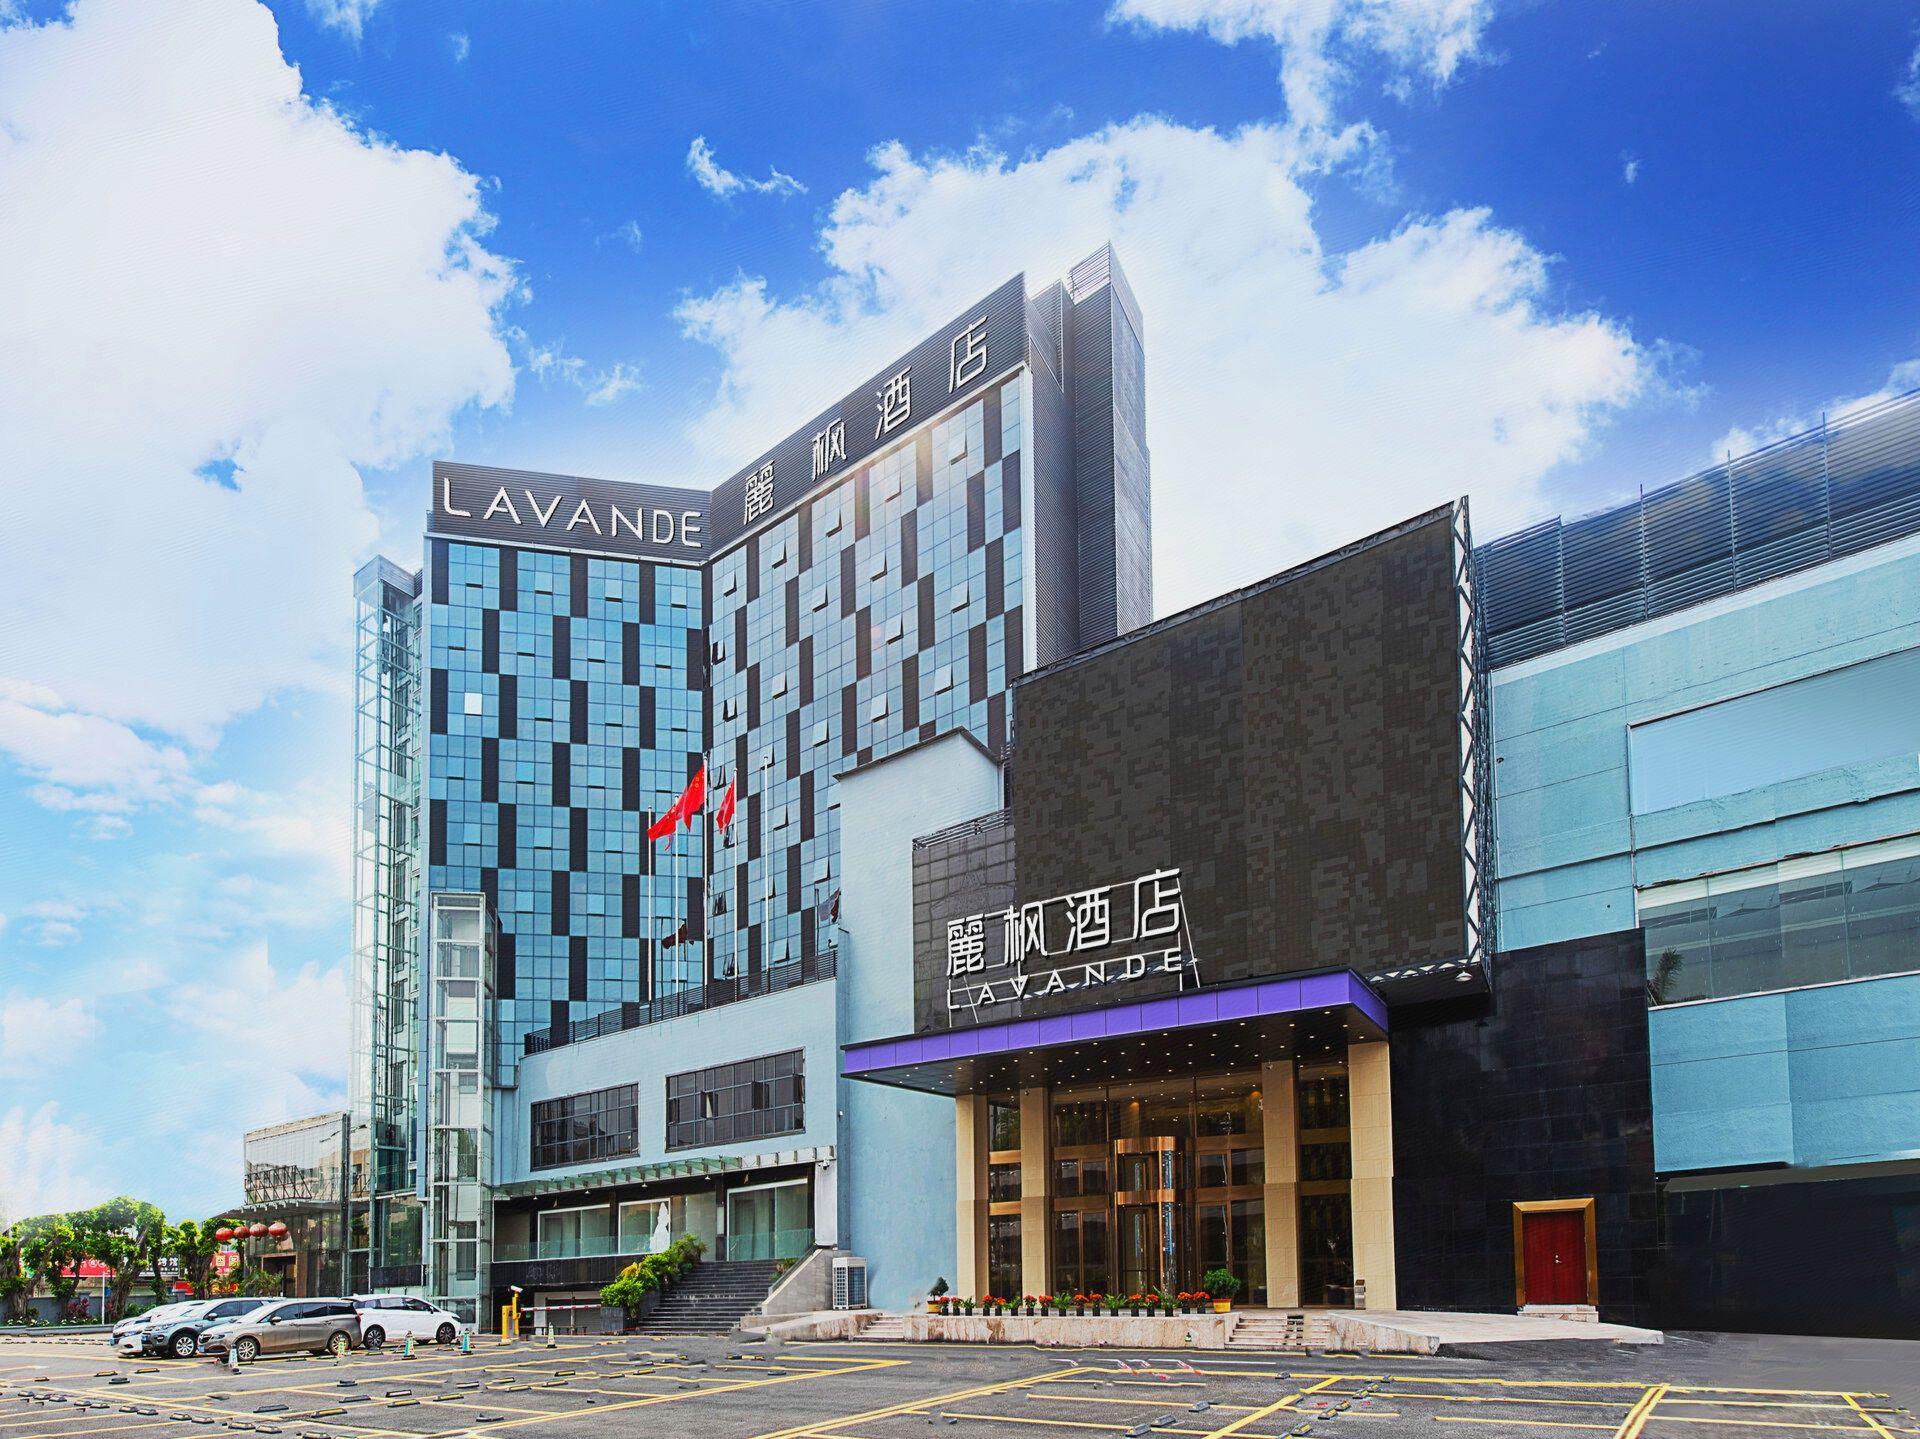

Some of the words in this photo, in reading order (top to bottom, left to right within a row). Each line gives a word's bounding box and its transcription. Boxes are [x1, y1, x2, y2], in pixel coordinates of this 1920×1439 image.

[744, 316, 988, 525] 麗枫酒店
[443, 477, 703, 548] LAVANDE
[946, 868, 1181, 976] 麗枫酒店
[946, 947, 1182, 1009] LAVANDE
